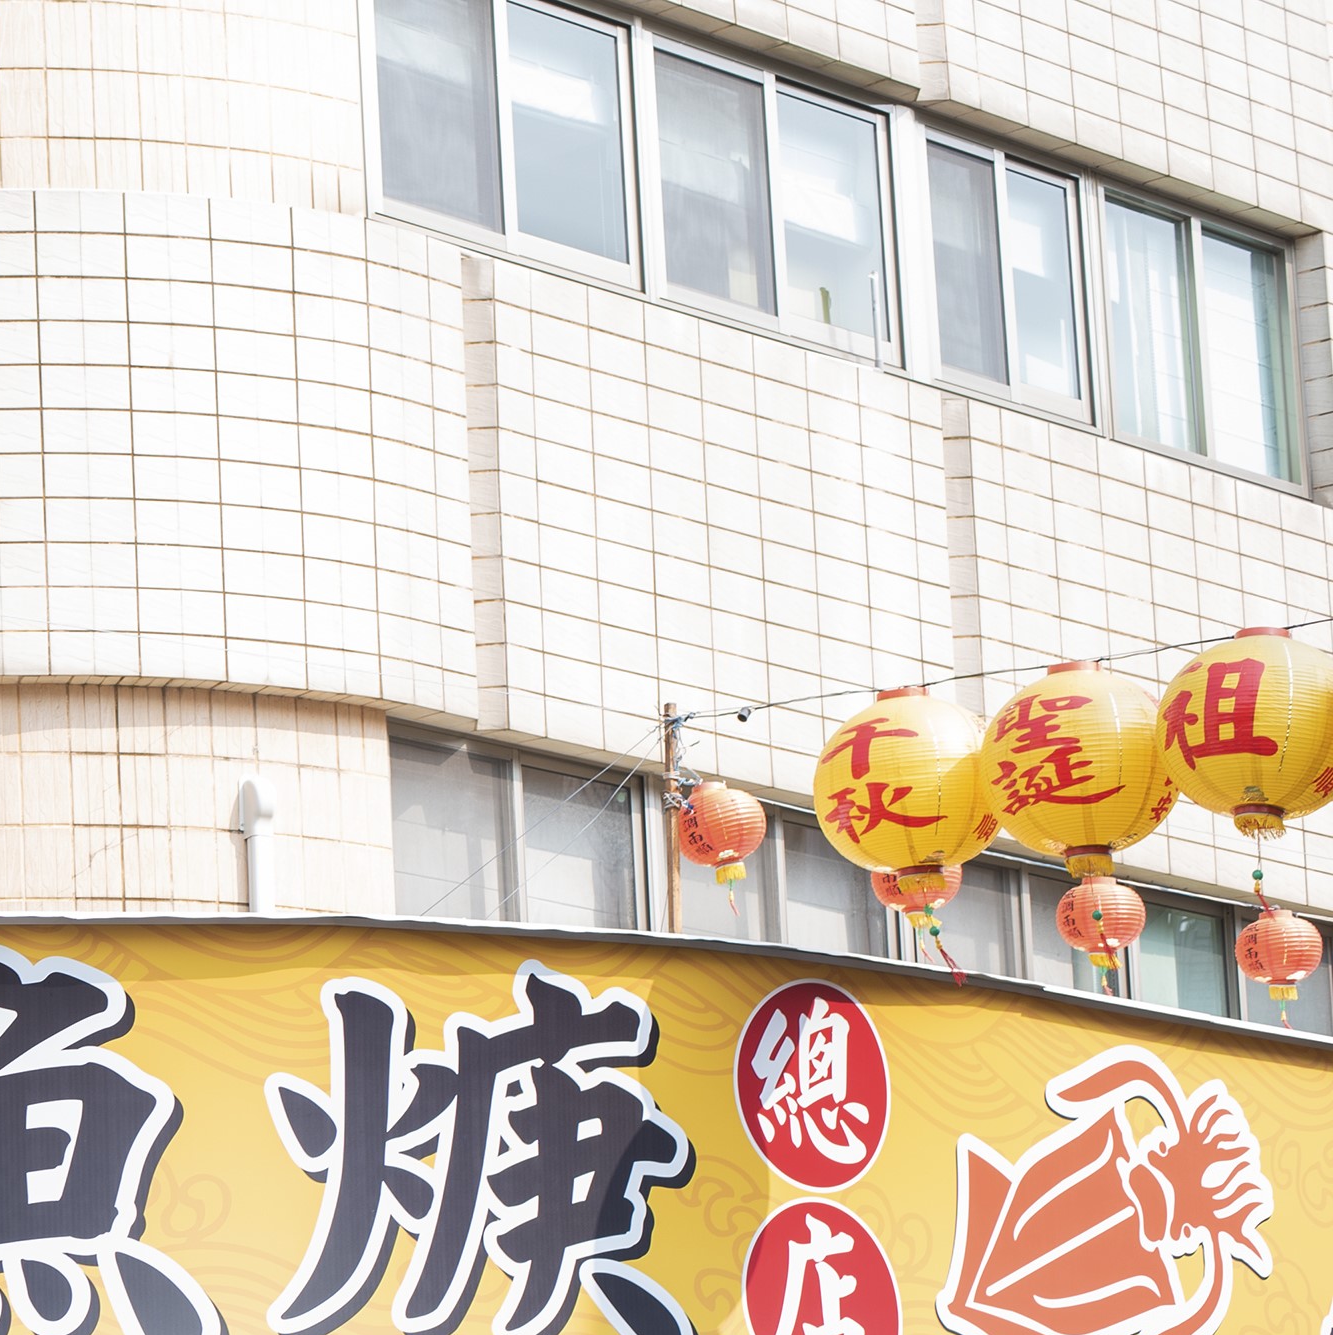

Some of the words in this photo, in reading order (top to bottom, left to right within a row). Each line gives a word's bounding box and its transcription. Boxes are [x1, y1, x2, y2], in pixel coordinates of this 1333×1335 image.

[990, 694, 1126, 815] 聖誕
[1163, 657, 1279, 770] 祖
[821, 716, 947, 844] 千秋
